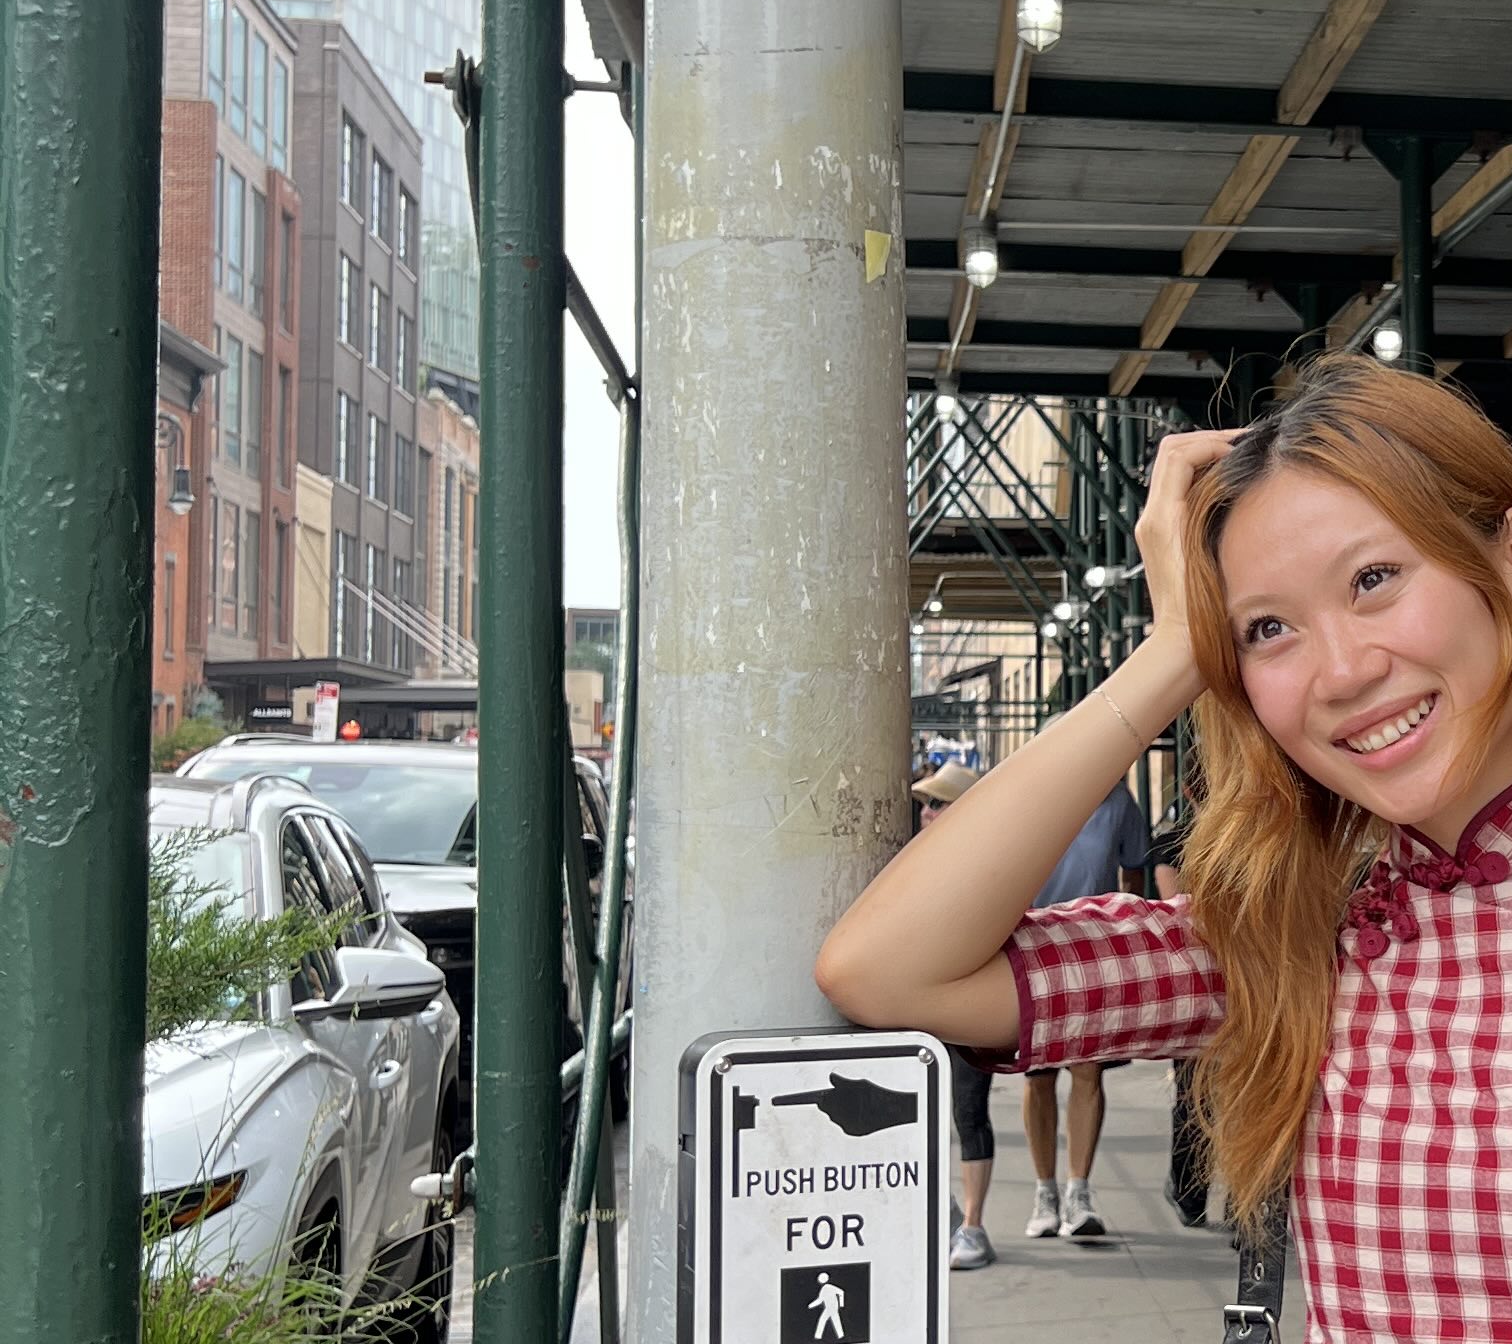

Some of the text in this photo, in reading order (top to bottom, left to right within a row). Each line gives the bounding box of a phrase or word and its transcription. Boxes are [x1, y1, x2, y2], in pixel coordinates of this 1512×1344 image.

[746, 1161, 920, 1198] PUSH BUTTON
[786, 1214, 865, 1251] FOR
